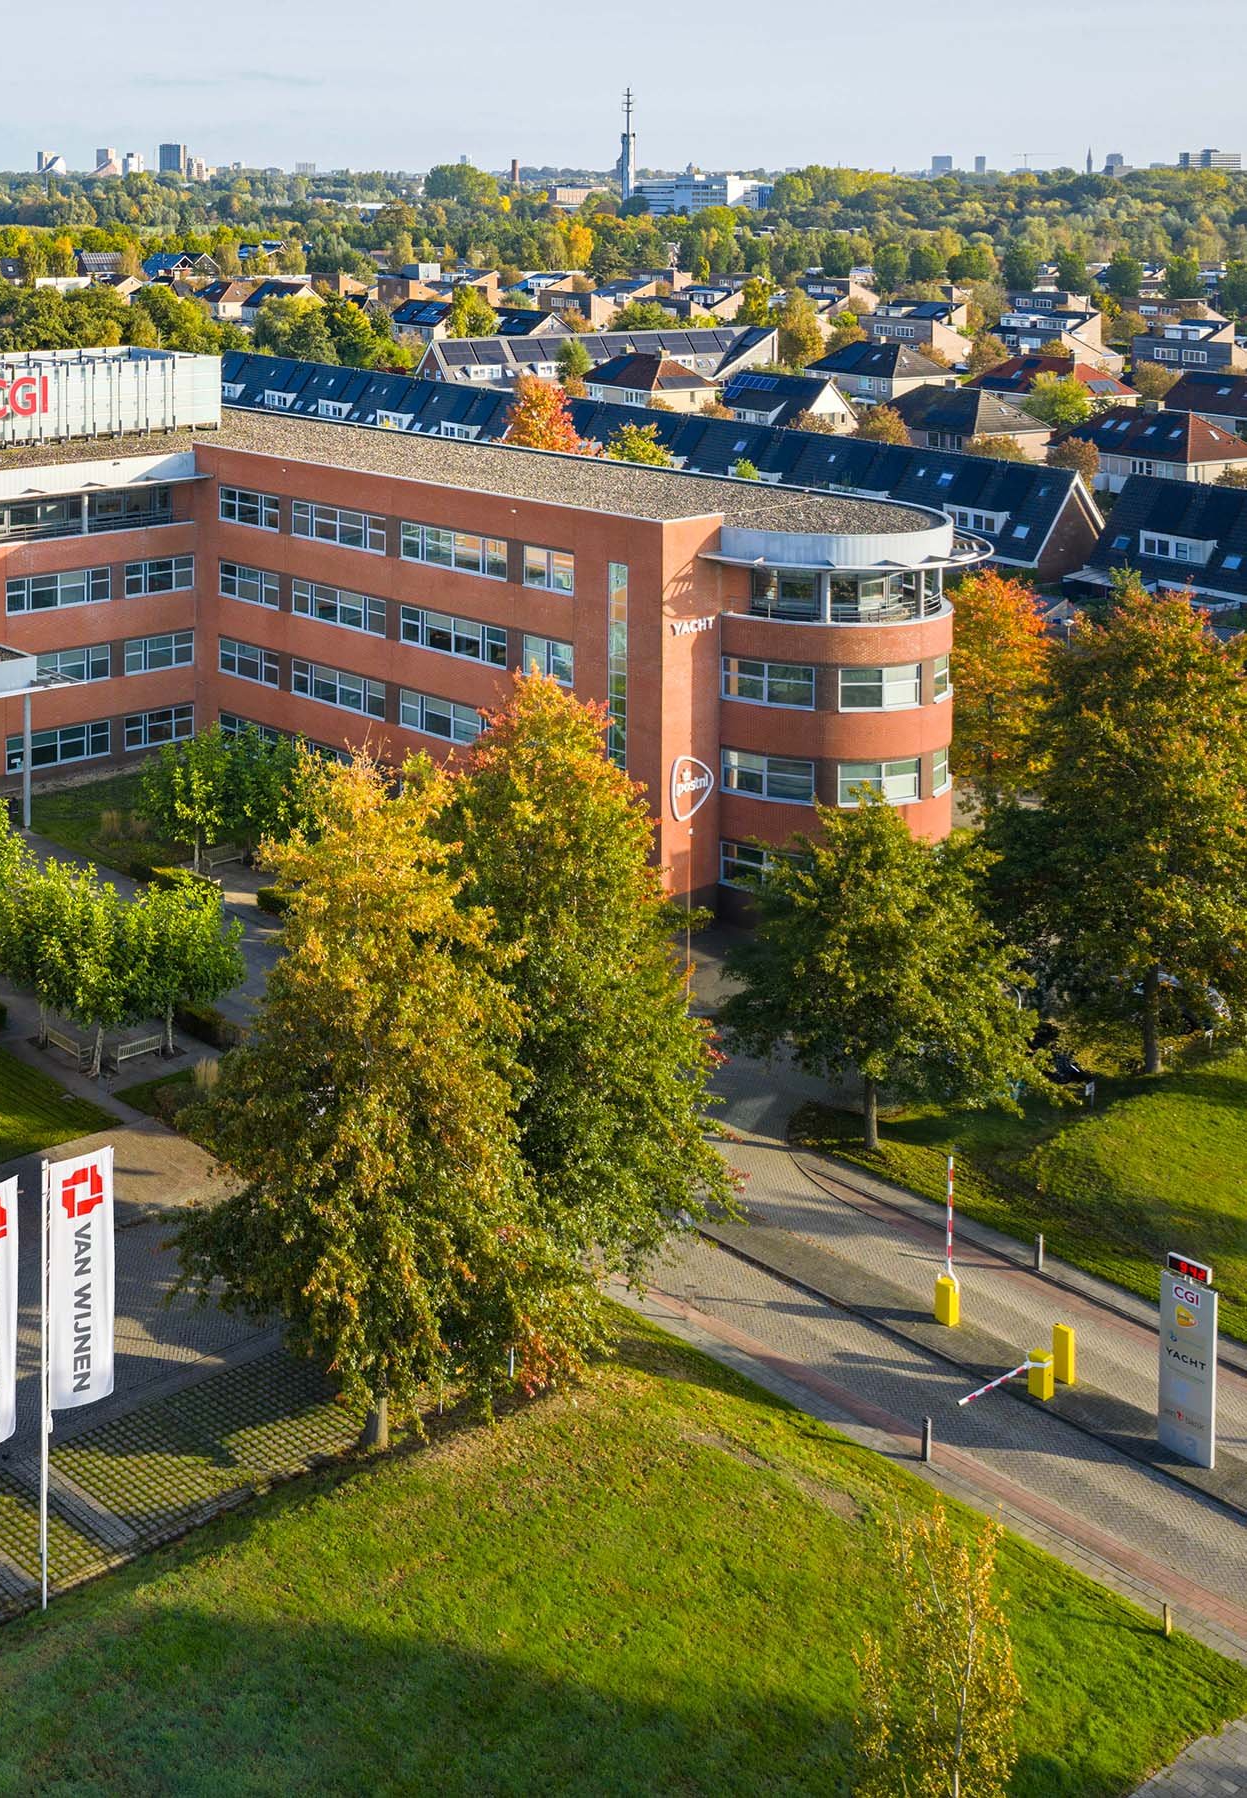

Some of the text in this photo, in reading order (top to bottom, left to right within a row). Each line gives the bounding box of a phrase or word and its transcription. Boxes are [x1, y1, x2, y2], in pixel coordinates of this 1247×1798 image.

[673, 616, 715, 636] YACHT
[675, 773, 708, 798] postnl
[73, 1221, 92, 1393] VAN WIJNEN
[1174, 1286, 1199, 1306] CGI
[1165, 1345, 1207, 1371] YACHT
